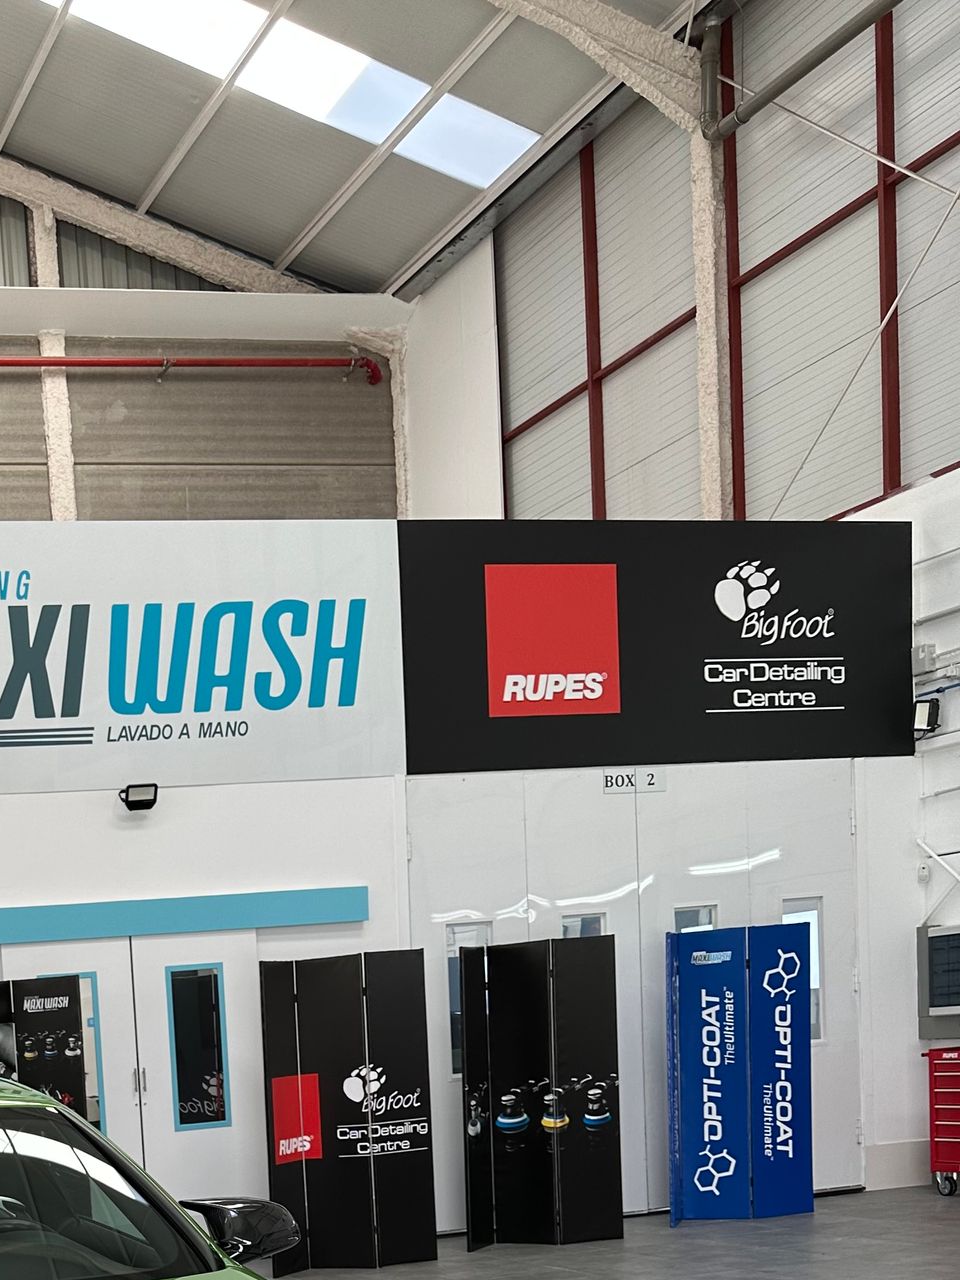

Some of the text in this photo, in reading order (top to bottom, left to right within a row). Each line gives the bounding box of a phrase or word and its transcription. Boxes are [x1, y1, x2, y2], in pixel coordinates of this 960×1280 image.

[107, 598, 366, 715] WASH
[733, 689, 816, 707] Centre
[107, 721, 249, 742] LAVADO A MANO
[604, 773, 655, 788] BOX 2
[701, 989, 722, 1143] OPTI-COAT
[775, 1004, 793, 1158] OPTI-COAT
[357, 1140, 410, 1154] Centre
